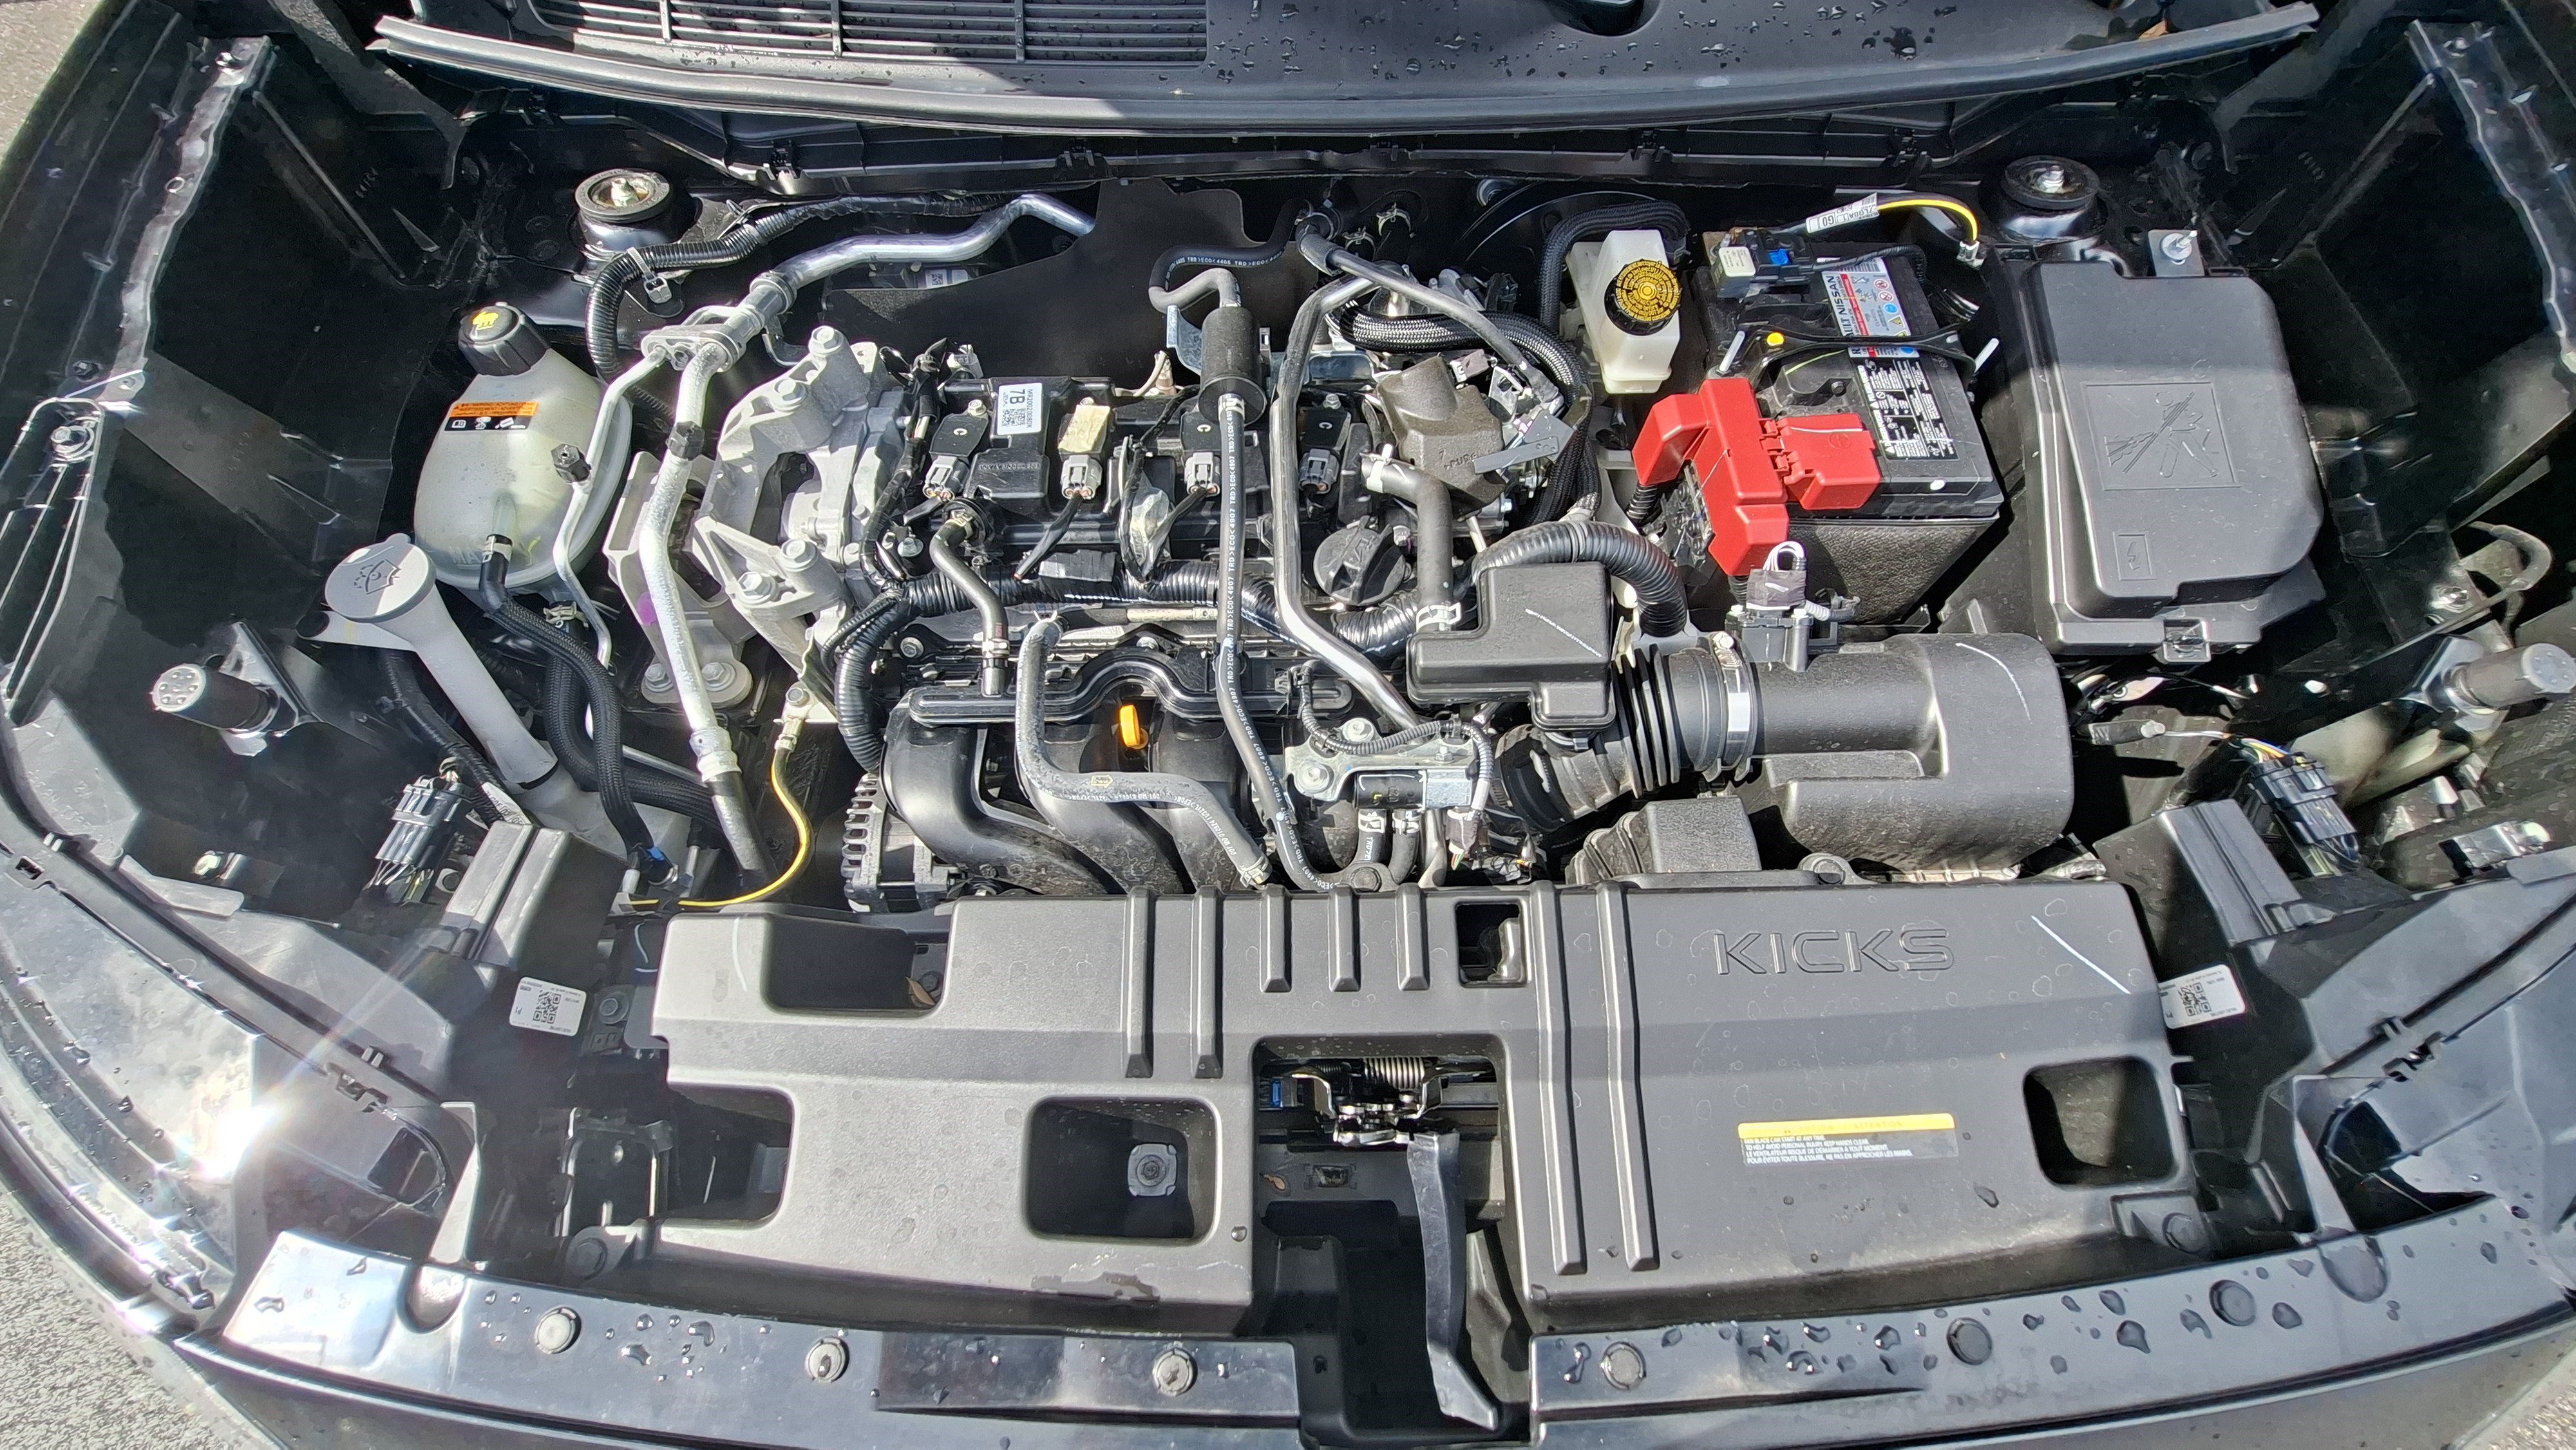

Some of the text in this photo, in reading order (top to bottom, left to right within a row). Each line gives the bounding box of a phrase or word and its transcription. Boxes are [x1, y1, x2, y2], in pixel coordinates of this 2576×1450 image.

[1826, 276, 1848, 315] NISSAN
[1009, 389, 1025, 404] 7B
[1229, 688, 1255, 740] TRD>ECO<4907
[1253, 743, 1283, 803] TRD>ECO<4907
[1713, 928, 1954, 975] KICKS
